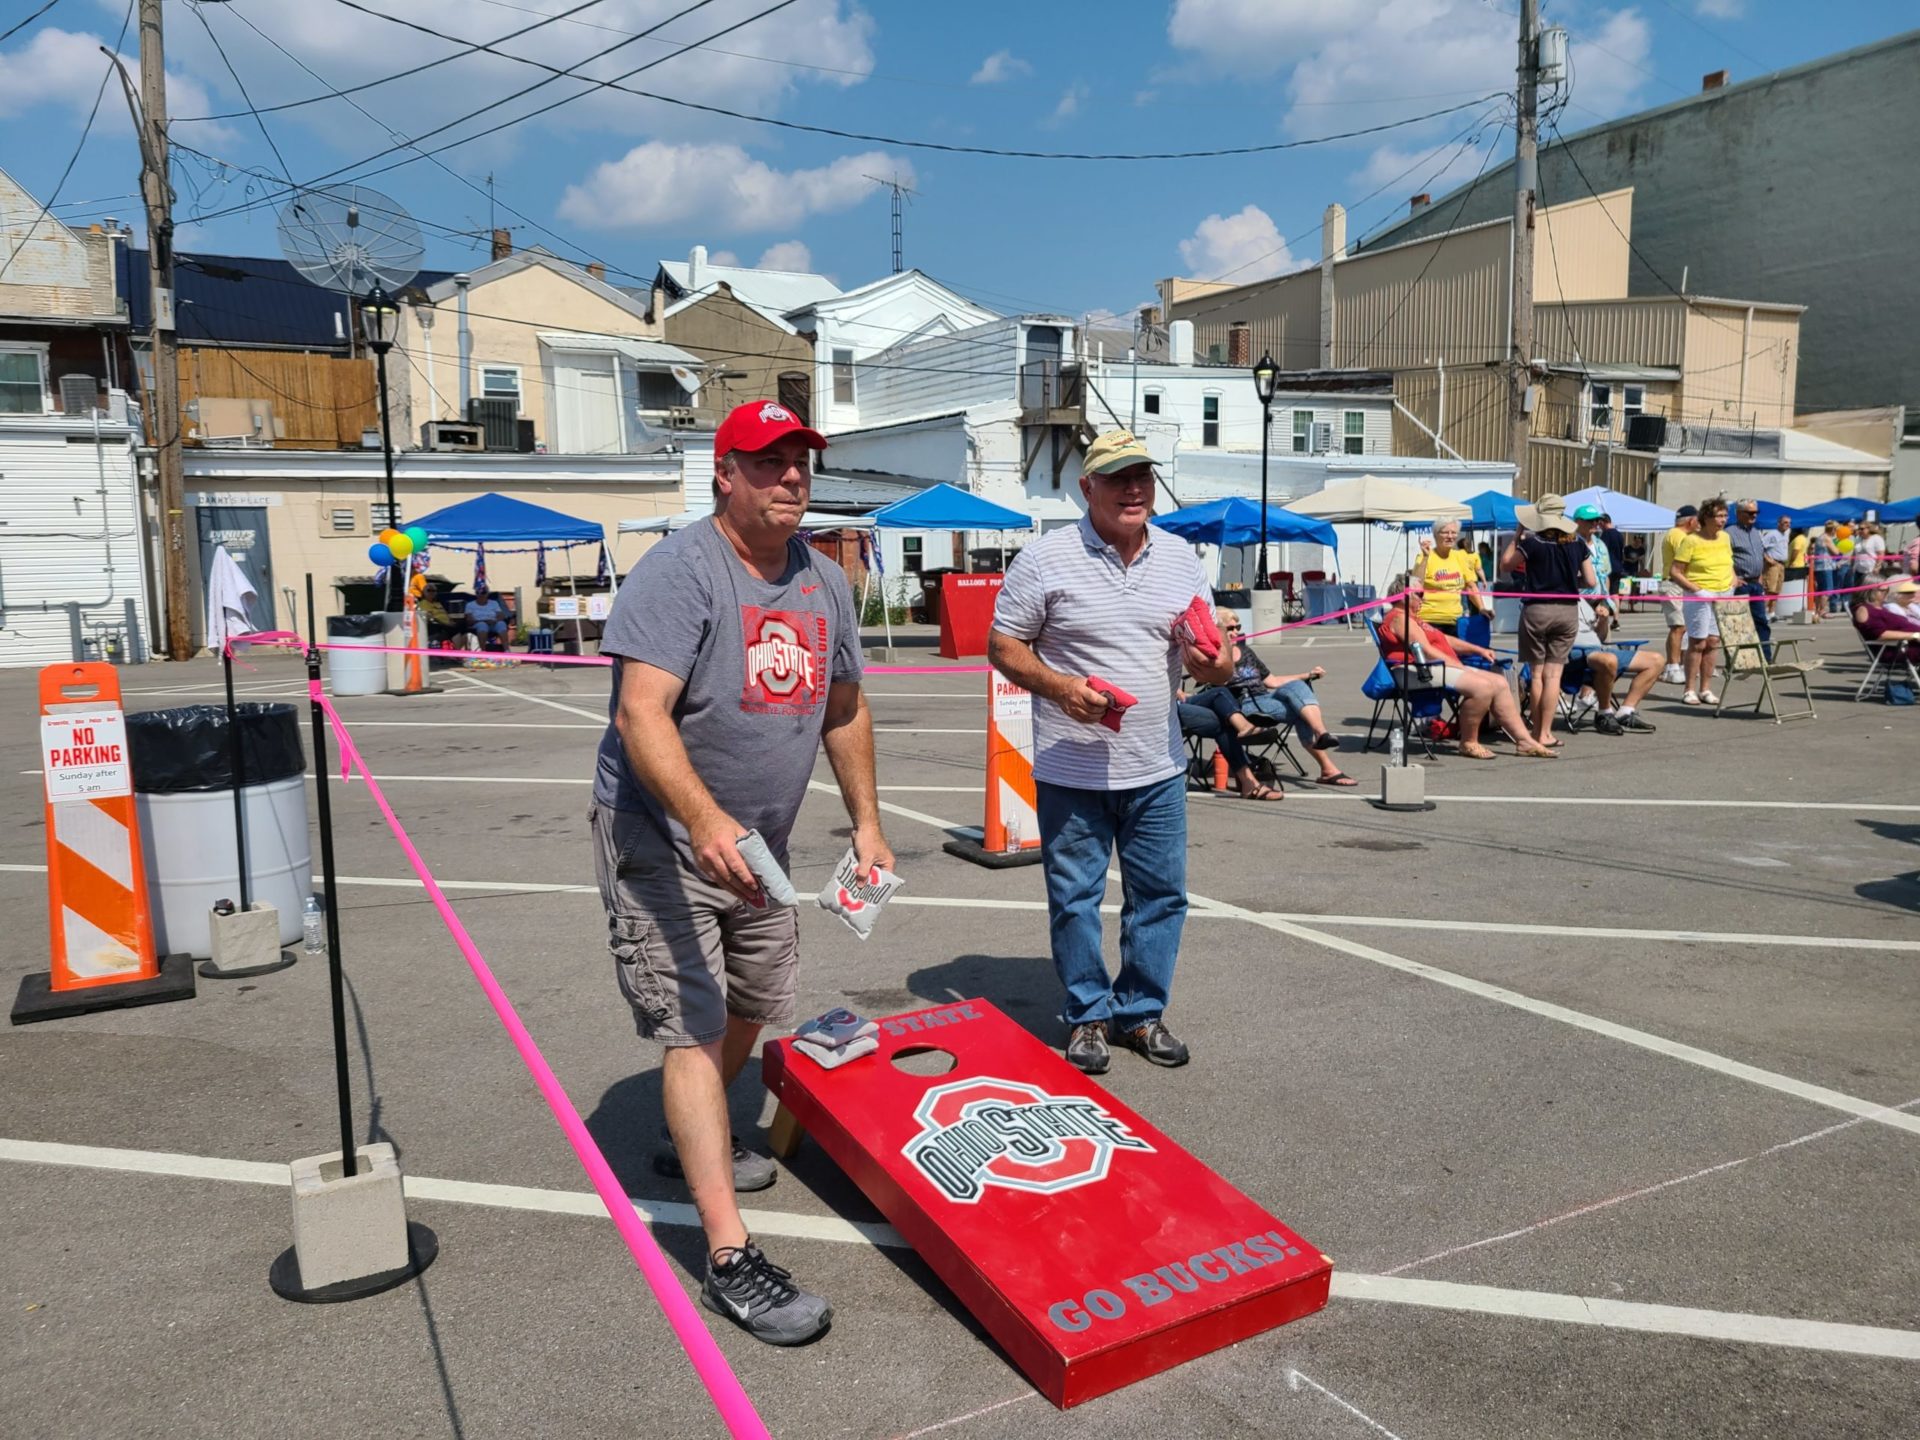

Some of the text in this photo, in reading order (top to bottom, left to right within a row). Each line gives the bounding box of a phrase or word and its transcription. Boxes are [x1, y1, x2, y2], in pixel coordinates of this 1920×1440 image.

[816, 617, 827, 699] OHIO STATE
[73, 727, 94, 746] NO
[50, 744, 121, 767] PARKING
[59, 769, 117, 780] Sunday after
[881, 1004, 985, 1036] STATE
[1047, 1230, 1302, 1333] GO BUCKS!
